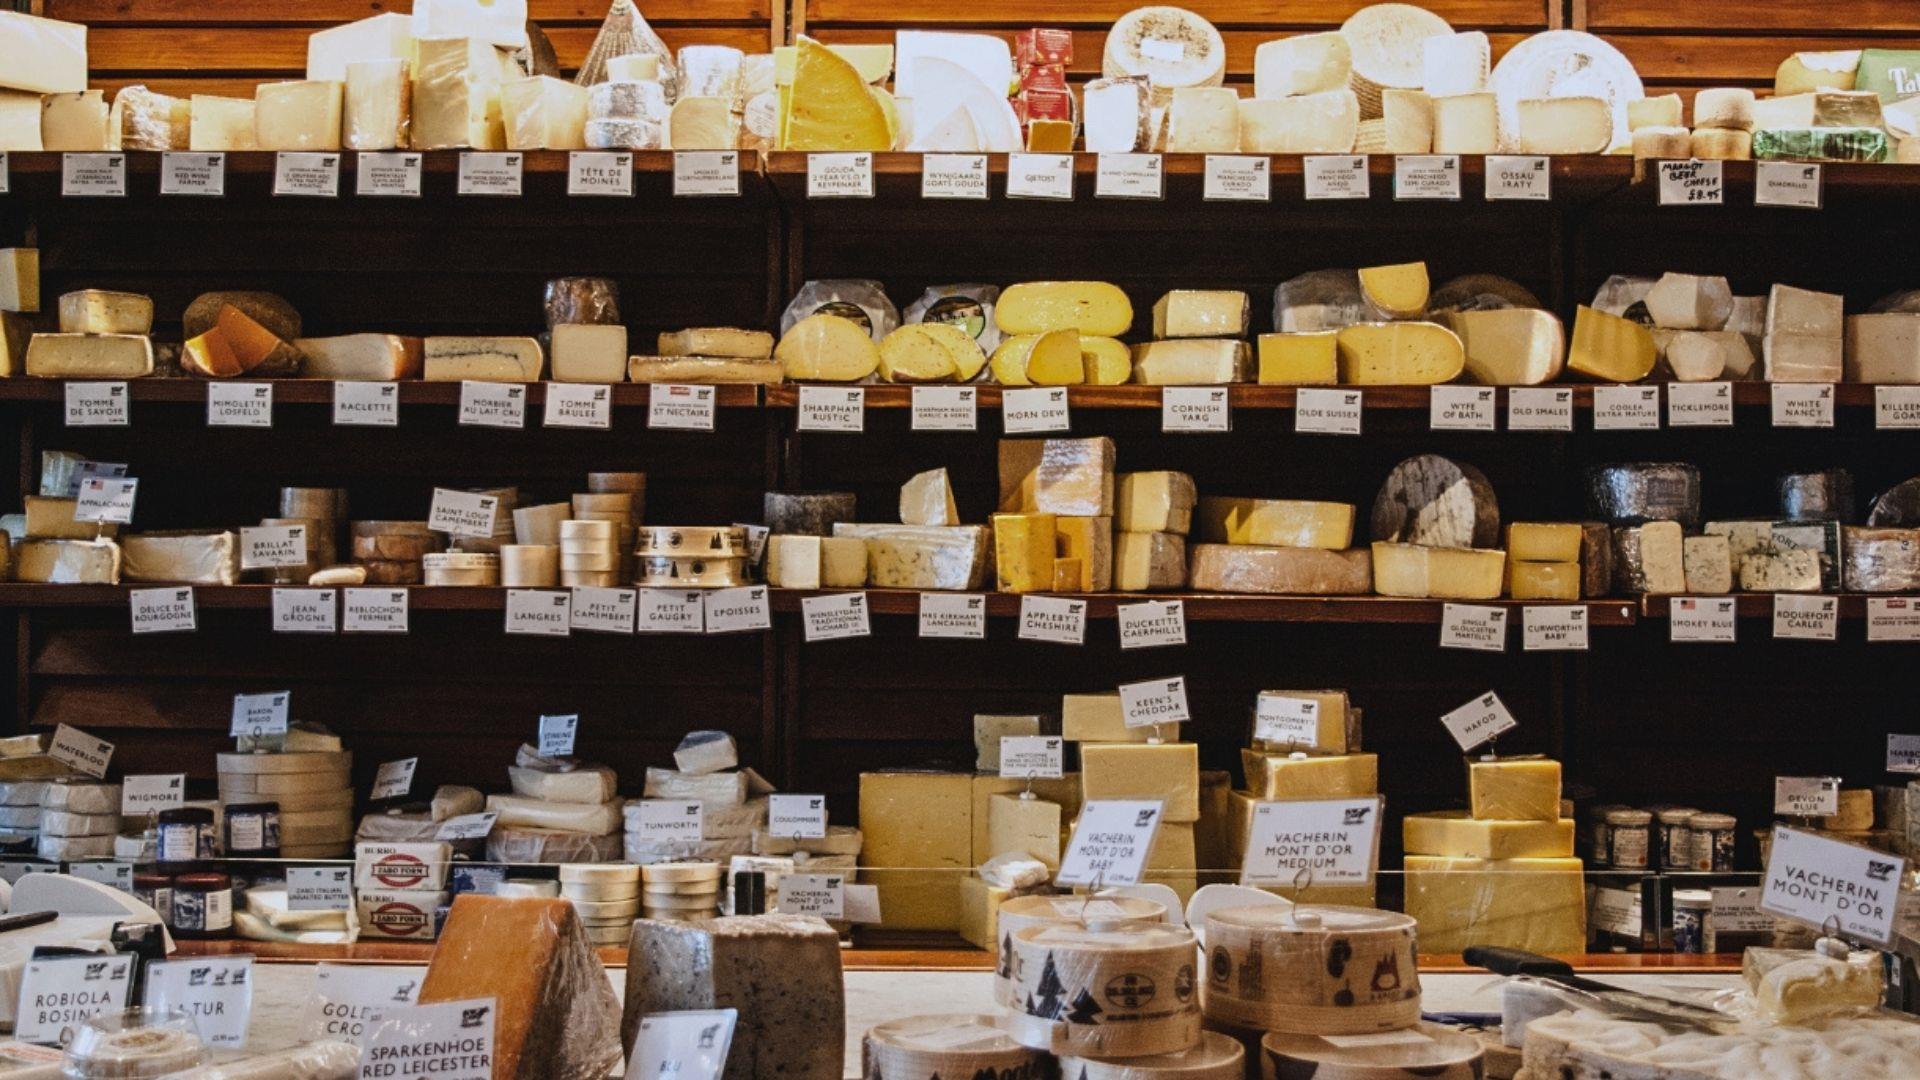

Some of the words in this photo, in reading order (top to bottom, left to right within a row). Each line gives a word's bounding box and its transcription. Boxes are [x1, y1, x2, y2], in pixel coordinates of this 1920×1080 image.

[824, 166, 855, 174] GOUDA
[1662, 162, 1704, 173] MARGOT
[1025, 174, 1056, 184] GJETOST
[1501, 171, 1535, 180] OSSAU
[1669, 171, 1697, 181] BEER
[580, 177, 622, 186] MOINES
[925, 179, 951, 188] GOATS
[1503, 181, 1533, 189] IRATY
[1683, 177, 1718, 188] CHEESE
[214, 400, 267, 408] MIMOLETTE
[341, 402, 392, 412] RACLETTE
[473, 399, 512, 408] MORBIER
[560, 400, 597, 409] TOMME
[1450, 402, 1476, 410] WYFE
[1609, 403, 1643, 411] COOLEA
[1672, 403, 1730, 412] TICKLEMORE
[1787, 400, 1822, 408] WHITE
[70, 408, 83, 416] DE
[87, 407, 123, 416] SAVOIE
[220, 407, 260, 416] LOSFELD
[464, 406, 477, 415] AU
[479, 407, 500, 416] LAIT
[502, 408, 521, 417] CRU
[654, 407, 665, 416] ST
[666, 408, 710, 417] NECTAIRE
[803, 404, 861, 413] SHARPHAM
[1171, 404, 1220, 413] CORNISH
[1512, 407, 1532, 415] OLD
[1534, 407, 1569, 416] SMALES
[1785, 408, 1822, 417] NANCY
[812, 413, 850, 422] RUSTIC
[1007, 410, 1038, 420] MORN
[1041, 408, 1065, 418] DEW
[1181, 413, 1210, 422] YARG
[1298, 408, 1323, 417] OLDE
[1326, 410, 1359, 419] SUSSEX
[1443, 411, 1456, 419] OF
[1458, 411, 1483, 420] BATH
[1596, 410, 1622, 418] EXTRA
[1625, 410, 1657, 418] MATURE
[80, 499, 131, 509] APPALACHIAN
[436, 506, 463, 517] SAINT
[465, 510, 490, 520] LOUP
[435, 514, 489, 529] CAMEMBERT
[253, 540, 294, 549] BRILLAT
[252, 548, 296, 558] SAVARIN
[173, 604, 186, 612] DE
[292, 605, 317, 614] JEAN
[589, 603, 616, 612] PETIT
[657, 604, 685, 612] PETIT
[134, 611, 192, 622] BOURGOGNE
[283, 613, 326, 622] GROGNE
[358, 614, 393, 622] FERMIER
[514, 612, 562, 621] LANGRES
[574, 610, 631, 621] CAMEMBERT
[649, 611, 692, 621] GAUGRY
[810, 608, 862, 619] WENSLEYDALE
[940, 613, 983, 621] KIRKHAM'S
[1027, 611, 1080, 624] APPLEBY'S
[1776, 610, 1835, 621] ROQUEFORT
[812, 615, 862, 626] TRADITIONAL
[926, 619, 977, 628] LANCASHIRE
[1462, 618, 1487, 627] SINGLE
[1672, 619, 1708, 628] SMOKEY
[1711, 620, 1733, 628] BLUE
[1787, 619, 1823, 629] CARLES
[816, 623, 849, 632] RICHARD
[1026, 620, 1078, 633] CHESHIRE
[1450, 625, 1497, 634] GLOUCESTER
[1527, 625, 1583, 633] CURWORTHY
[1123, 626, 1182, 638] CAERPHILLY
[1545, 632, 1567, 640] BABY
[1136, 695, 1173, 708] KEEN'S
[1130, 703, 1181, 719] CHEDDAR
[1269, 722, 1304, 732] CHEDDAR
[1464, 712, 1497, 734] HAFOD
[56, 741, 105, 768] WATERLOO
[129, 793, 178, 801] WIGMORE
[1788, 794, 1825, 803] DEVON
[1793, 803, 1819, 811] BLUE
[644, 822, 699, 831] TUNWORTH
[1088, 833, 1136, 845] VACHERIN
[1275, 832, 1349, 843] VACHERIN
[1079, 845, 1109, 857] MONT
[1110, 847, 1135, 858] D'OR
[1265, 845, 1308, 856] MONT
[1315, 844, 1353, 855] D'OR
[1089, 860, 1113, 870] BABY
[1277, 858, 1337, 869] MEDIUM
[1785, 864, 1879, 901] VACHERIN
[785, 897, 810, 905] MONT
[1773, 879, 1830, 904] MONT
[1836, 896, 1884, 921] D'OR
[35, 991, 111, 1007] ROBIOLA
[193, 1002, 224, 1015] TUR
[38, 1007, 101, 1024] BOSIN
[371, 1037, 485, 1061] SPARKENHOE
[362, 1064, 396, 1079] RED
[402, 1055, 491, 1077] LEICESTER
